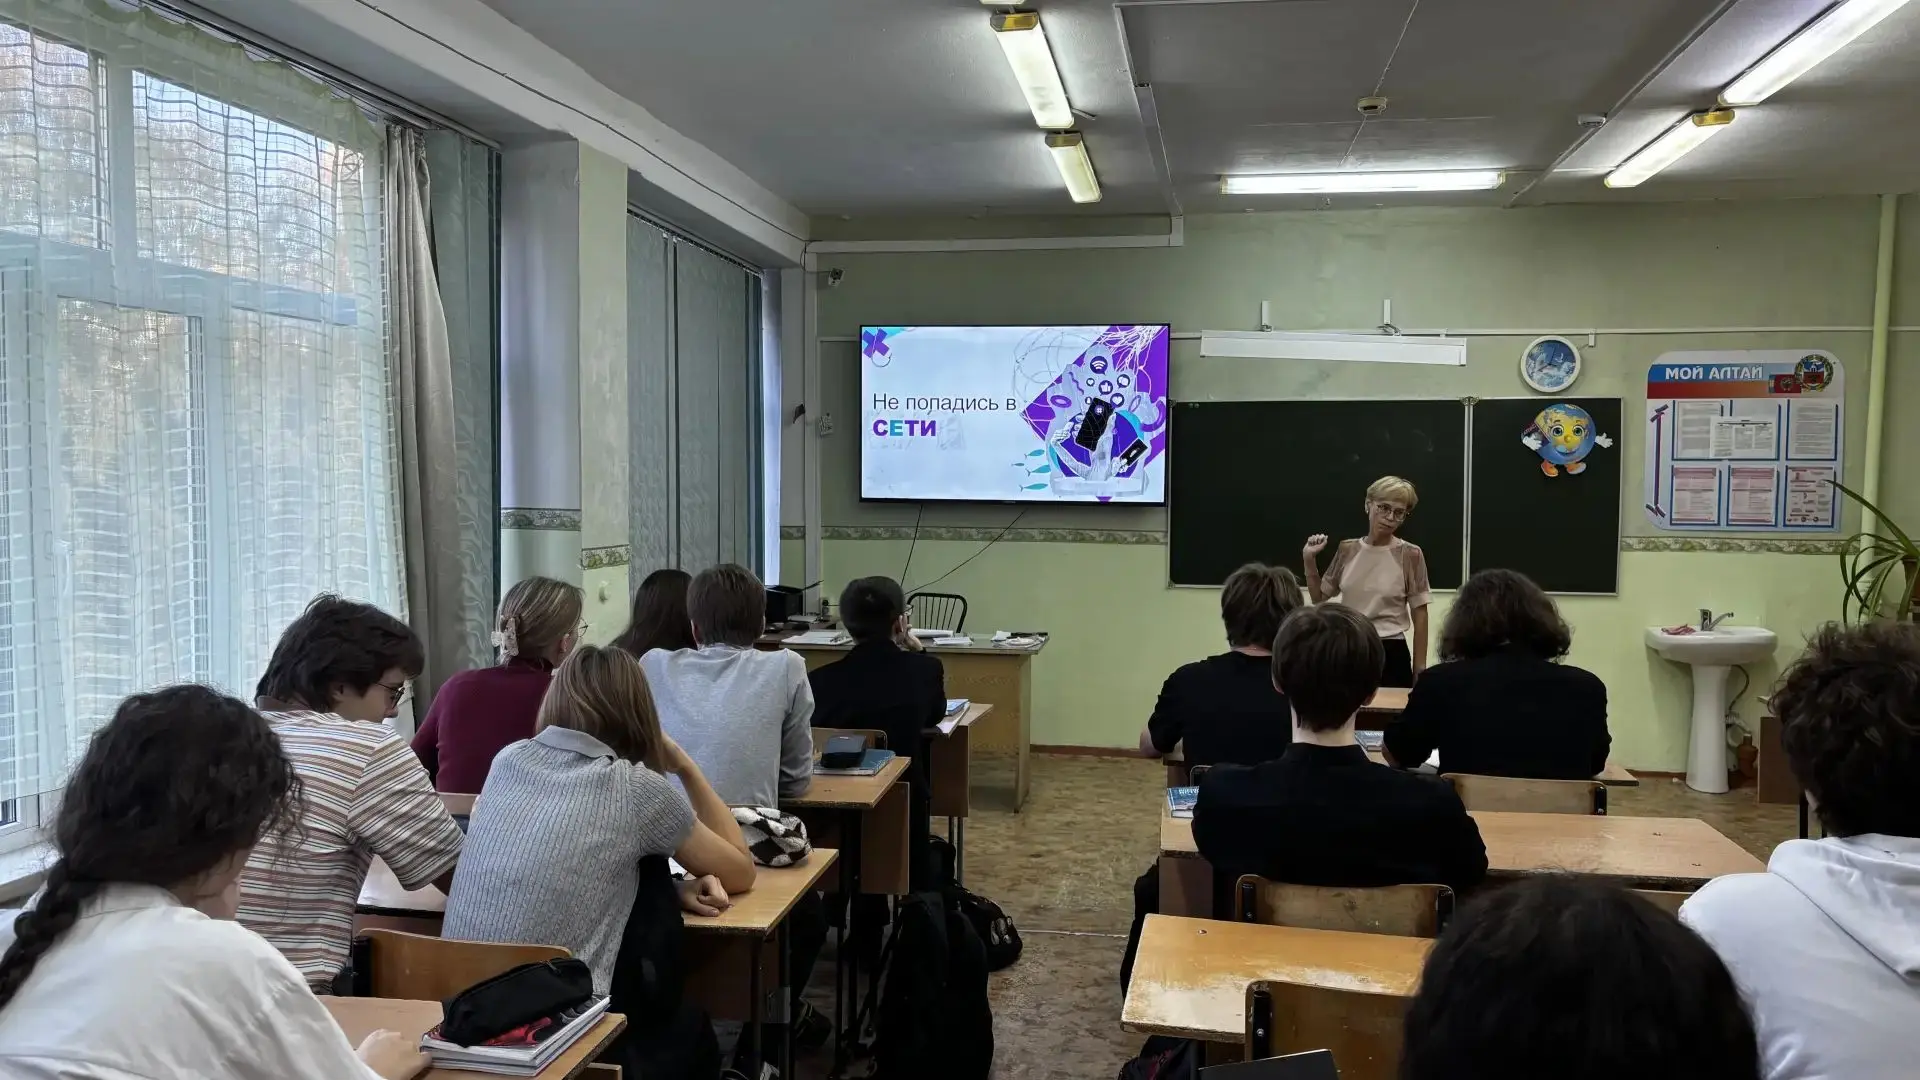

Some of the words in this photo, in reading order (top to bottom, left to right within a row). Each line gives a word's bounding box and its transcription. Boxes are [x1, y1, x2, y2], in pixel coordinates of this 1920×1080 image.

[1665, 365, 1704, 380] МОЙ
[1708, 365, 1763, 380] АЛТАЙ
[873, 393, 899, 410] Не
[906, 397, 999, 414] попадись
[1006, 398, 1017, 410] в
[872, 419, 937, 437] СЕТИ
